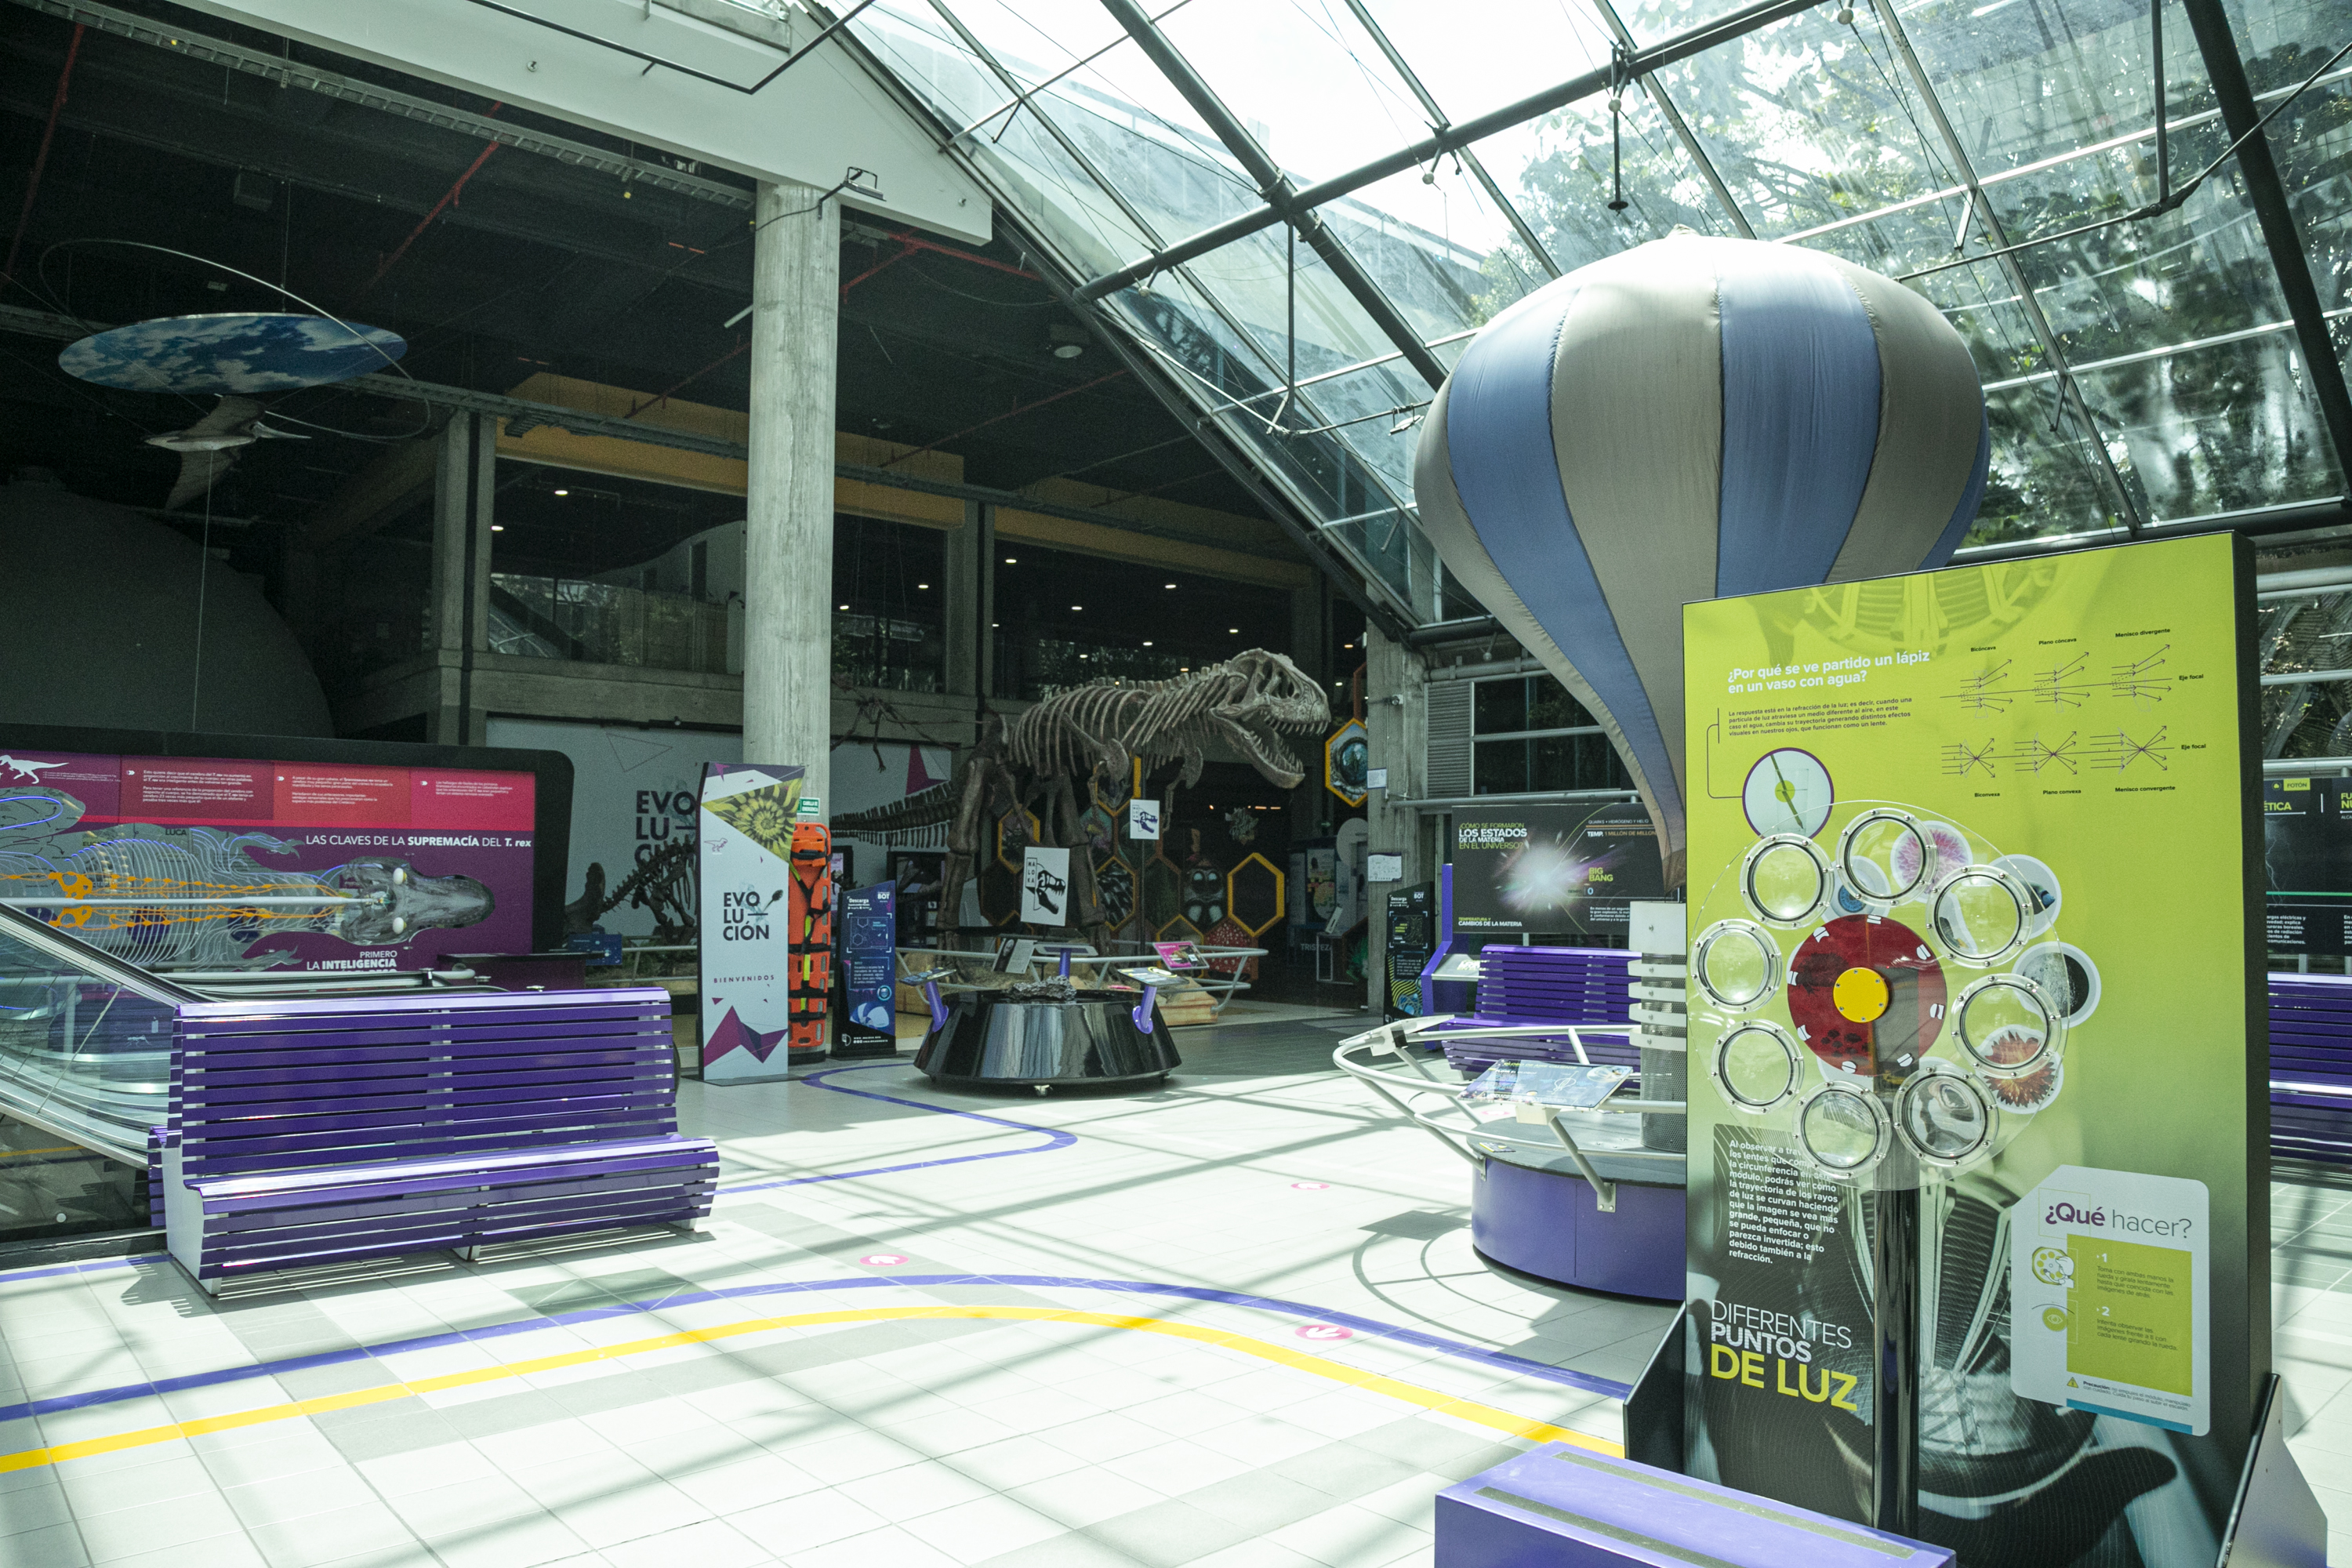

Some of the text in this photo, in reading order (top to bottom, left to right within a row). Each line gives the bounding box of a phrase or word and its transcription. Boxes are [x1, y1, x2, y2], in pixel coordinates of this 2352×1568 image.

[2140, 628, 2170, 637] divergente
[1728, 651, 1929, 683] ¿Por qué se ve partido un lápiz
[1728, 670, 1867, 693] en un vaso con agua?
[637, 790, 697, 815] EVO
[636, 817, 670, 840] LU
[1459, 828, 1527, 837] LOS ESTADOS
[306, 835, 326, 844] LAS
[329, 835, 371, 845] CLAVES
[373, 836, 389, 845] DE
[391, 837, 405, 845] LA
[408, 835, 479, 847] SUPREMACÍA
[482, 837, 501, 847] DEL
[505, 838, 512, 847] T.
[724, 891, 760, 906] EVO
[724, 909, 744, 924] LU
[723, 921, 769, 941] CIÓN
[307, 961, 320, 971] LA
[322, 958, 397, 970] INTELIGENCIA
[713, 975, 775, 983] BIENVENIDOS
[1739, 1161, 1798, 1176] circunferencia
[1730, 1171, 1762, 1182] módulo,
[1765, 1175, 1794, 1185] podrás
[1813, 1181, 1836, 1192] cómo
[1739, 1181, 1783, 1195] trayectoria
[1786, 1188, 1797, 1196] de
[1799, 1190, 1812, 1199] los
[1814, 1193, 1838, 1203] rayos
[1730, 1200, 1744, 1209] que
[1757, 1204, 1788, 1215] imagen
[1820, 1214, 1838, 1223] más
[1742, 1192, 1754, 1200] luz
[1768, 1196, 1796, 1207] curvan
[1799, 1200, 1838, 1213] haciendo
[1730, 1210, 1835, 1233] grande, pequeña, que no
[1741, 1222, 1766, 1232] pueda
[1769, 1226, 1801, 1238] enfocar
[2045, 1203, 2192, 1239] ¿Qué hacer?
[1730, 1231, 1824, 1252] parezca invertida; esto
[1730, 1240, 1758, 1250] debido
[1759, 1245, 1794, 1257] también
[1804, 1252, 1812, 1261] la
[1730, 1250, 1773, 1264] refracción.
[2102, 1254, 2107, 1262] 1
[2102, 1306, 2110, 1316] 2
[1711, 1300, 1852, 1348] DIFERENTES
[1711, 1321, 1812, 1363] PUNTOS
[1711, 1343, 1857, 1411] DE LUZ
